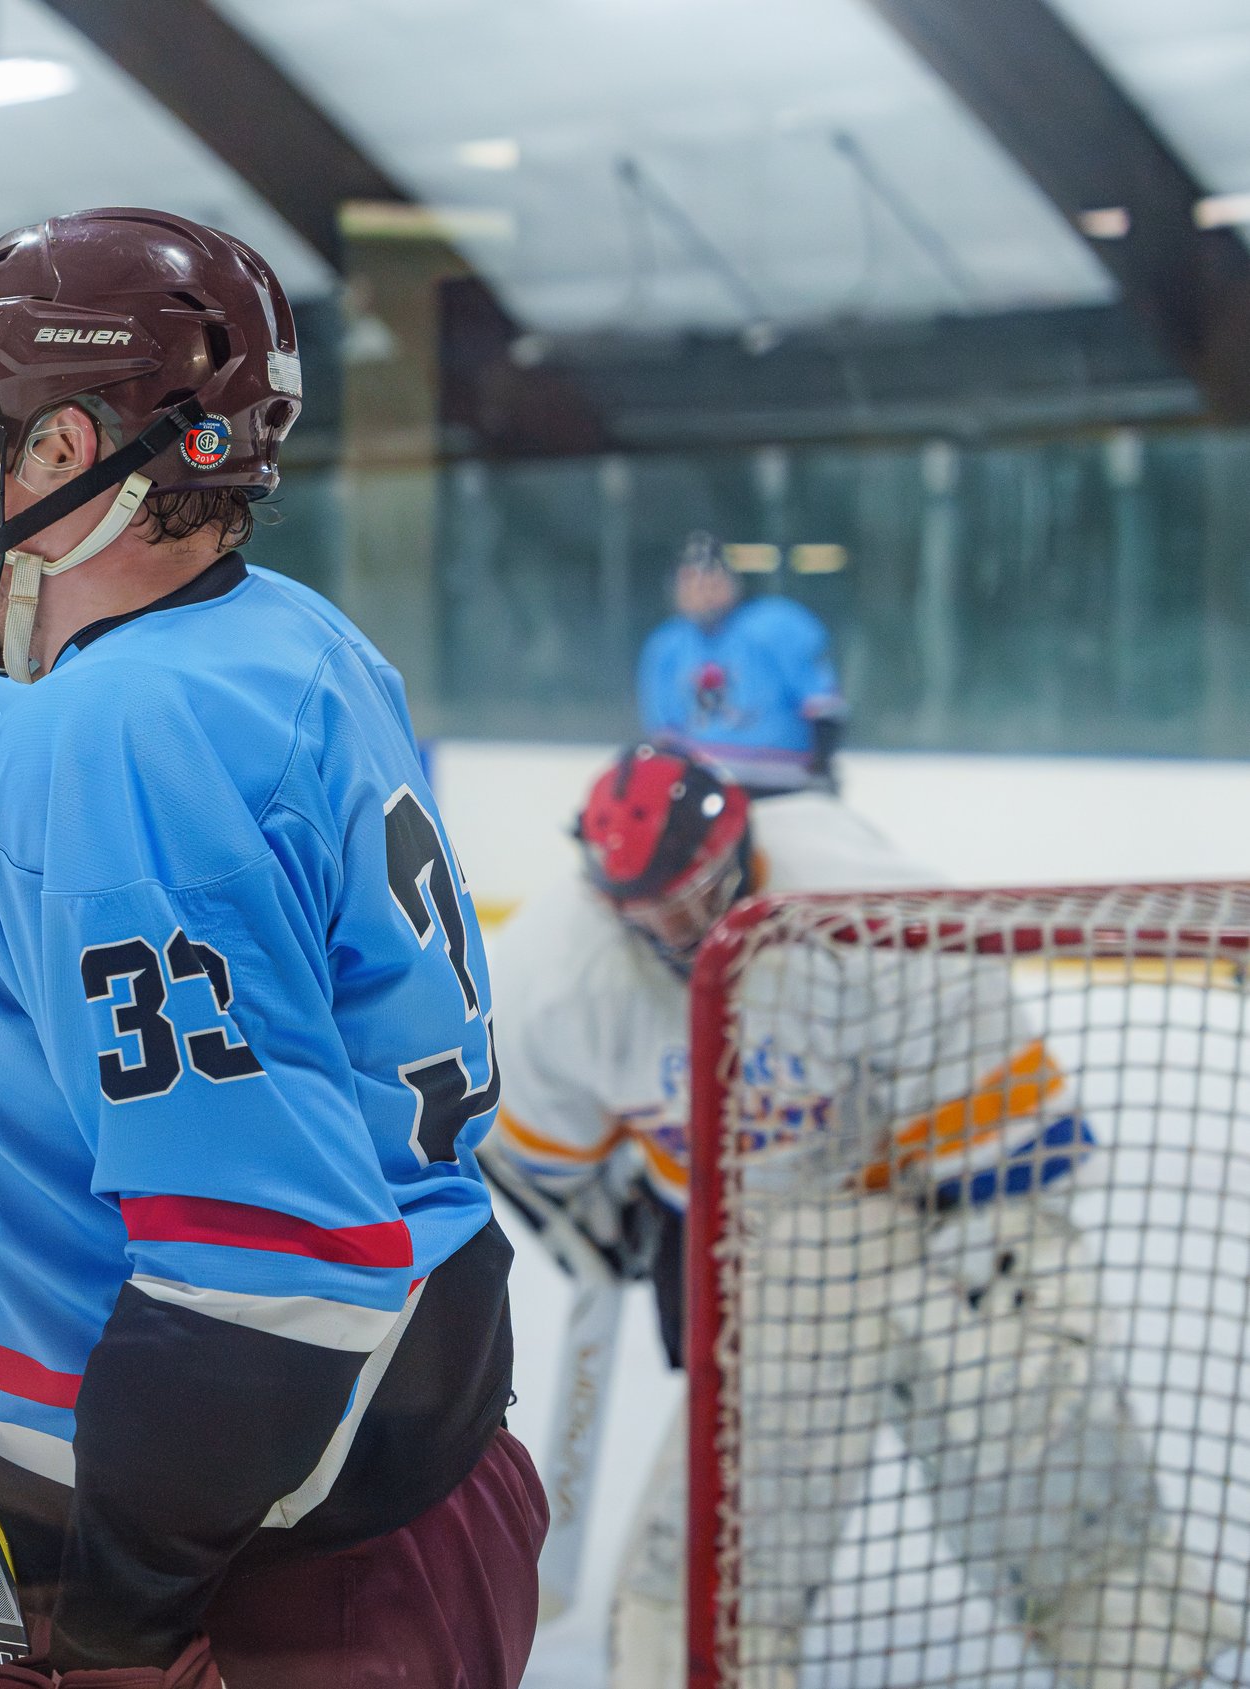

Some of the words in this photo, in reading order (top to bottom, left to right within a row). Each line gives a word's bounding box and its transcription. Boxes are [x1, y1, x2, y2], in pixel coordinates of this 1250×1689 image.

[33, 327, 133, 346] BAUER
[197, 462, 219, 470] HOCKEY
[79, 926, 268, 1106] 33
